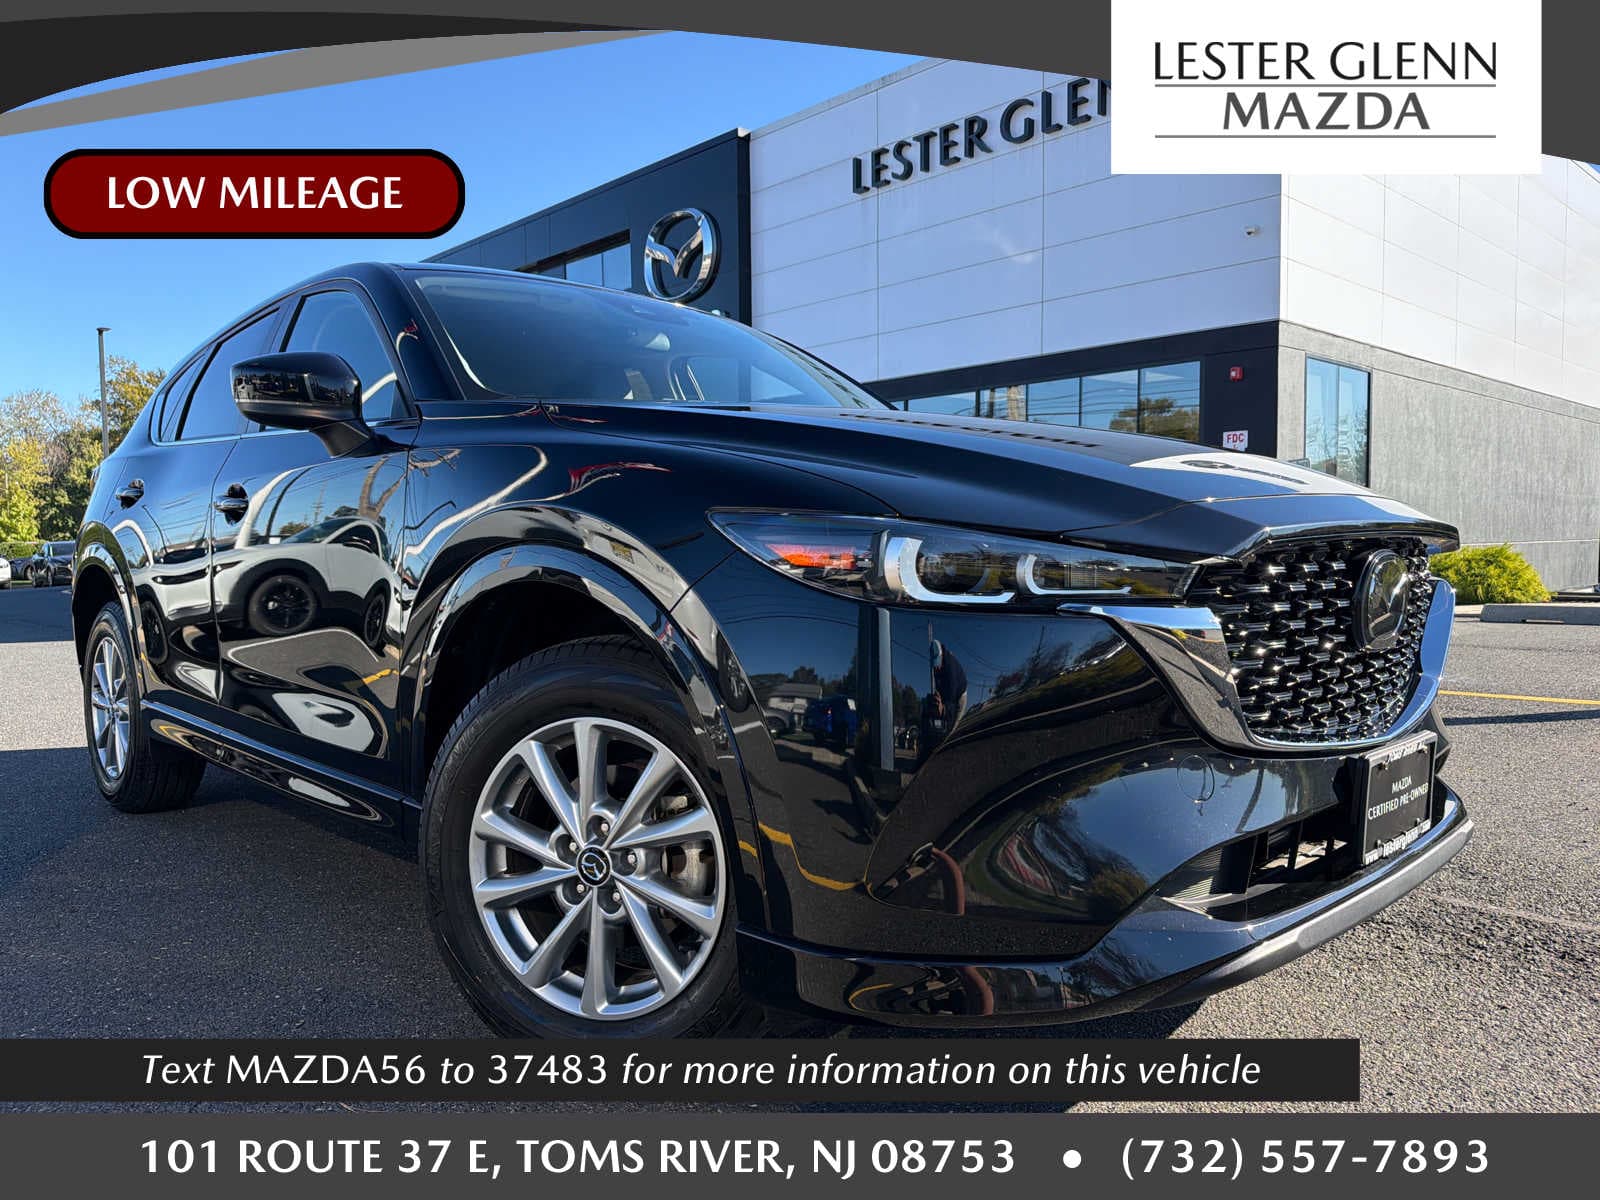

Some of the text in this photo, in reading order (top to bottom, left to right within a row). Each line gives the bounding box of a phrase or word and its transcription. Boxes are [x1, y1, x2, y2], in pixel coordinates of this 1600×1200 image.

[852, 115, 994, 195] LESTER
[1226, 433, 1245, 444] FDC
[1391, 775, 1413, 794] MAZDA
[1368, 782, 1429, 821] CERTIFIED PRE-OWNED
